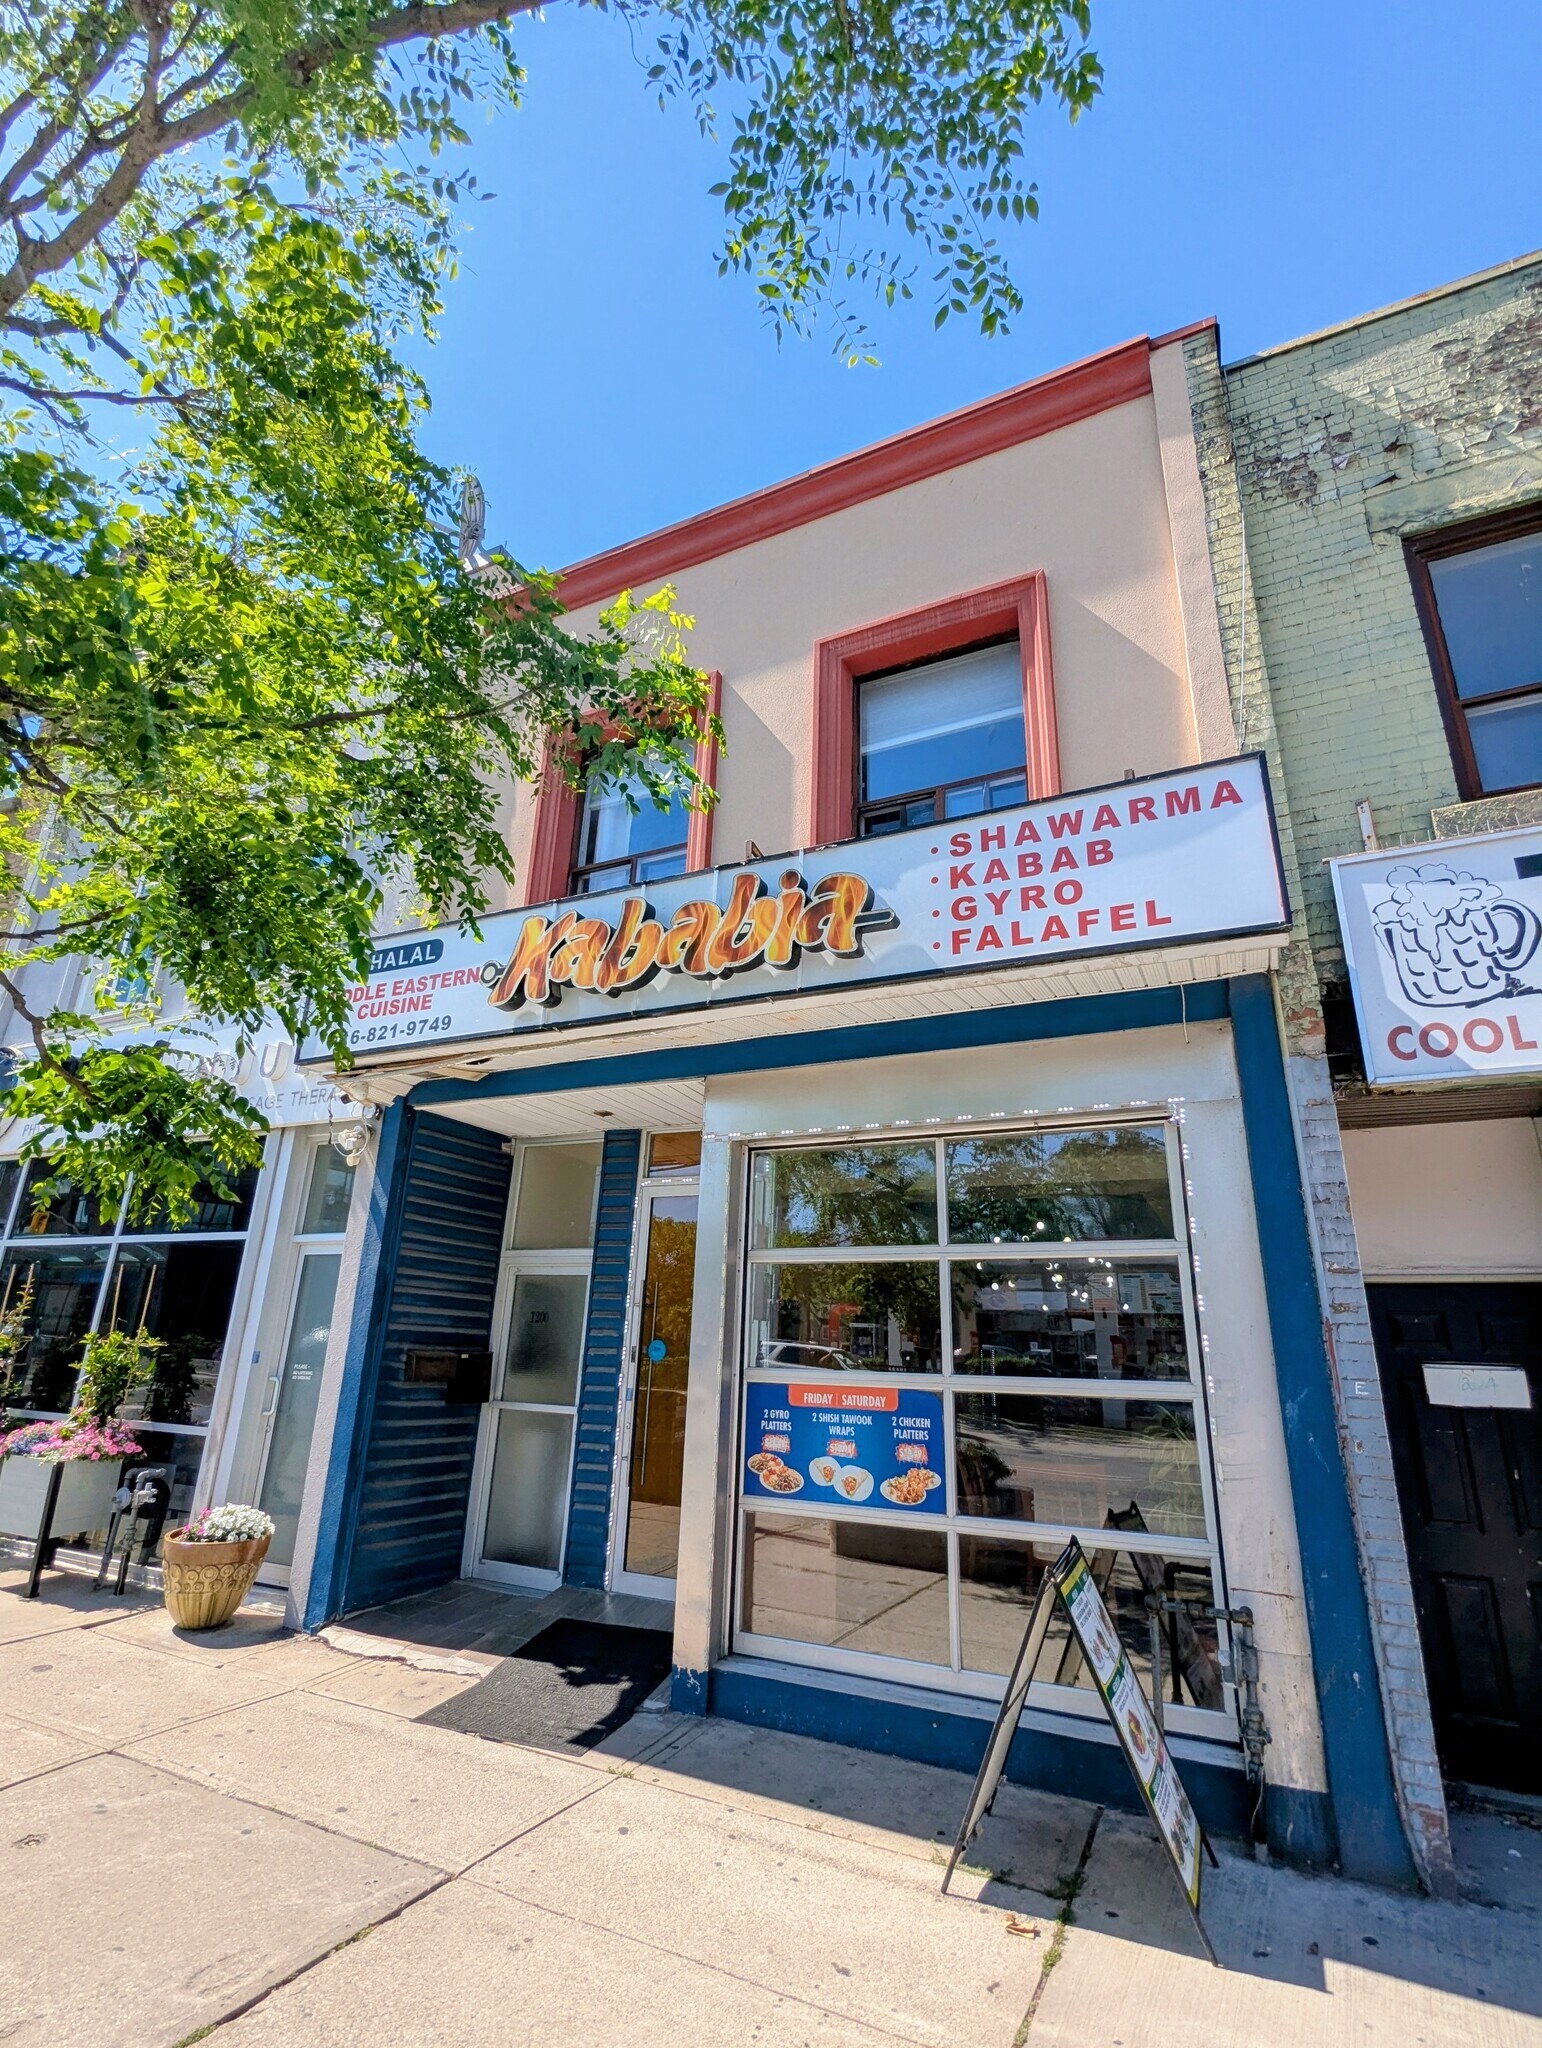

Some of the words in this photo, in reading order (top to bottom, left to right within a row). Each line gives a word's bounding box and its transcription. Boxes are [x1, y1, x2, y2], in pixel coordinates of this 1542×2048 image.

[949, 779, 1244, 858] SHAWARMA
[949, 838, 1114, 890] KABAB
[950, 879, 1083, 922] GYRO
[489, 870, 873, 1005] Kababia
[951, 900, 1173, 955] FALAFEL
[370, 944, 437, 970] HALAL
[341, 982, 388, 1003] DDLE
[391, 966, 481, 997] EASTERN
[357, 993, 433, 1020] CUISINE
[350, 1014, 452, 1045] 6-821-9749
[1386, 1014, 1539, 1062] COOL
[803, 1392, 833, 1405] FRIDAY
[841, 1393, 887, 1408] SATURDAY
[761, 1420, 792, 1432] PLATTERS
[763, 1409, 769, 1419] 2
[770, 1410, 790, 1420] GYRO
[812, 1412, 817, 1422] 2
[818, 1413, 840, 1424] SHISH
[841, 1415, 873, 1426] TAWOOK
[892, 1416, 897, 1426] 2
[899, 1417, 931, 1429] CHICKEN
[828, 1425, 855, 1437] WRAPS
[893, 1429, 929, 1441] PLATTERS
